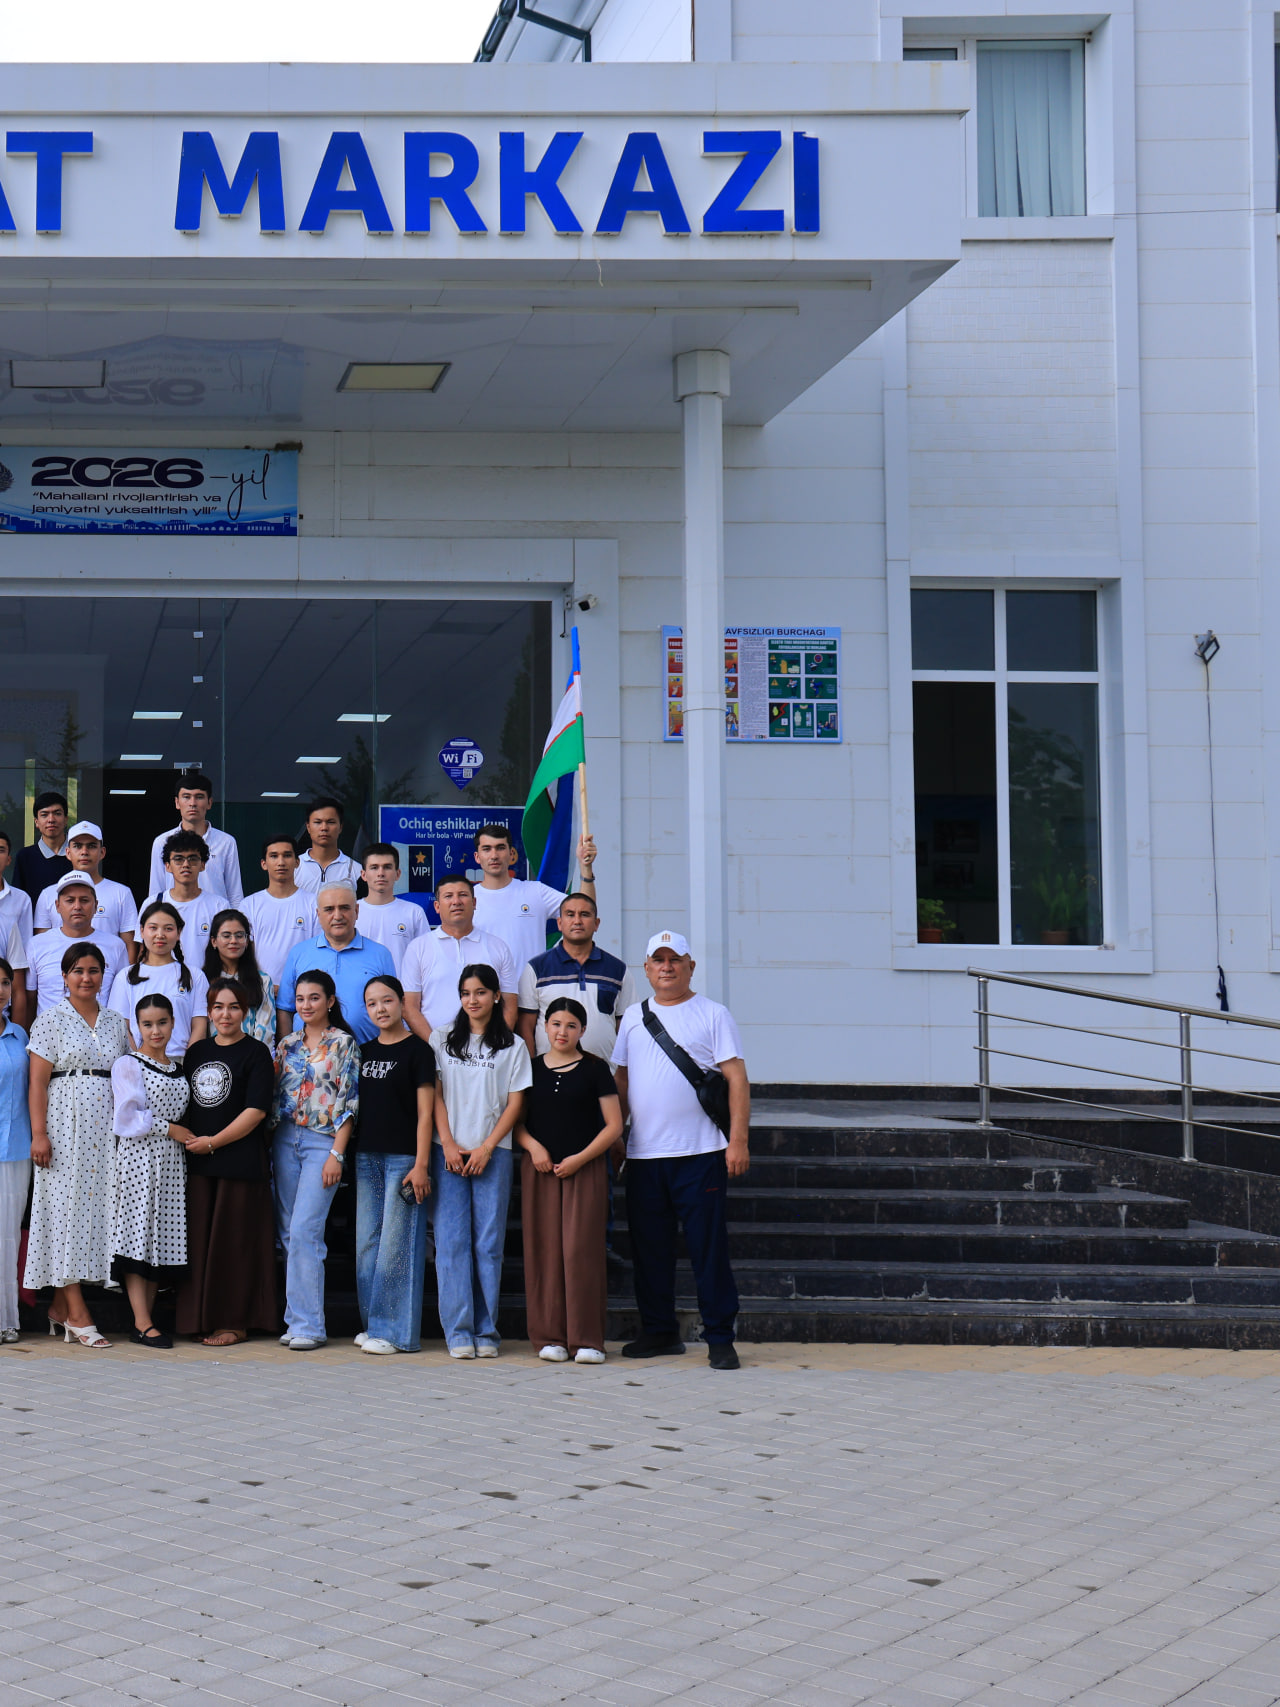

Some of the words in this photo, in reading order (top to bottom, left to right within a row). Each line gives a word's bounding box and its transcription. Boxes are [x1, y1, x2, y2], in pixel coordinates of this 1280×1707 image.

[174, 130, 821, 236] MARKAZI
[112, 492, 198, 503] rivojlantirish
[105, 505, 188, 515] yuksaltirish
[725, 627, 775, 636] AVFSIZLIGI
[776, 628, 826, 636] BURCHAGI
[399, 817, 433, 832] Ochiq
[435, 817, 481, 830] eshiklar
[412, 866, 431, 877] VIP!
